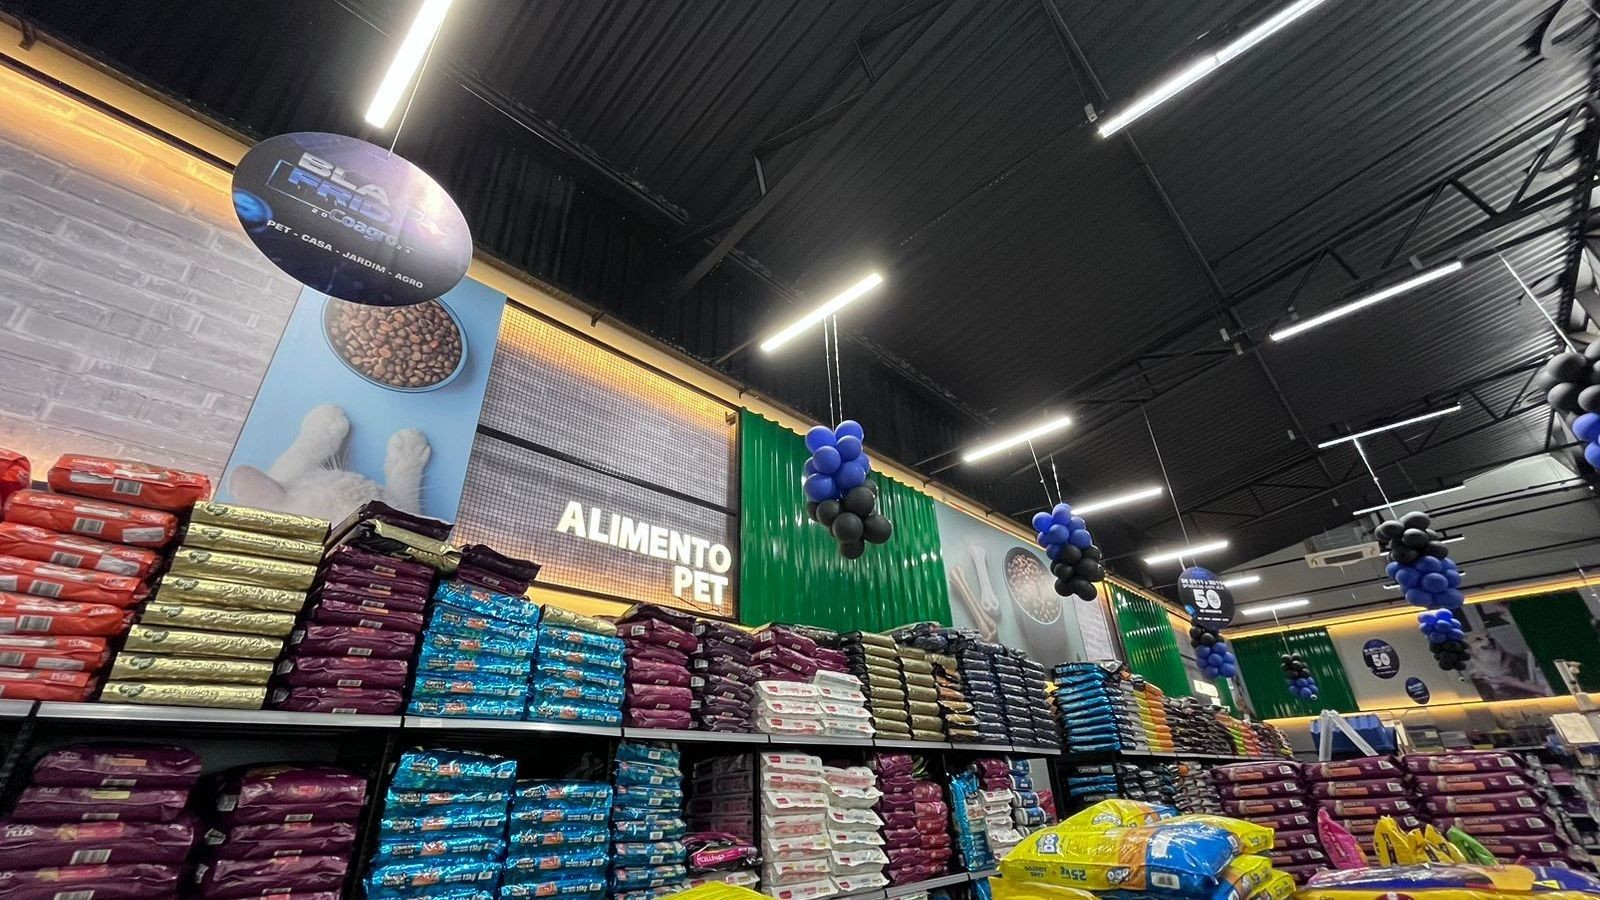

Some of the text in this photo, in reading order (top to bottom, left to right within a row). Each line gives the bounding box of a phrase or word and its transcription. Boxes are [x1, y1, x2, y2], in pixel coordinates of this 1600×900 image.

[329, 208, 401, 246] Coagro
[266, 219, 292, 234] PET
[301, 234, 333, 252] CASA
[342, 249, 387, 274] JARDIM
[394, 273, 424, 289] AGRO
[556, 500, 732, 574] ALIMENTO
[673, 565, 728, 606] PET
[1193, 589, 1221, 609] 50
[1372, 653, 1390, 667] 50
